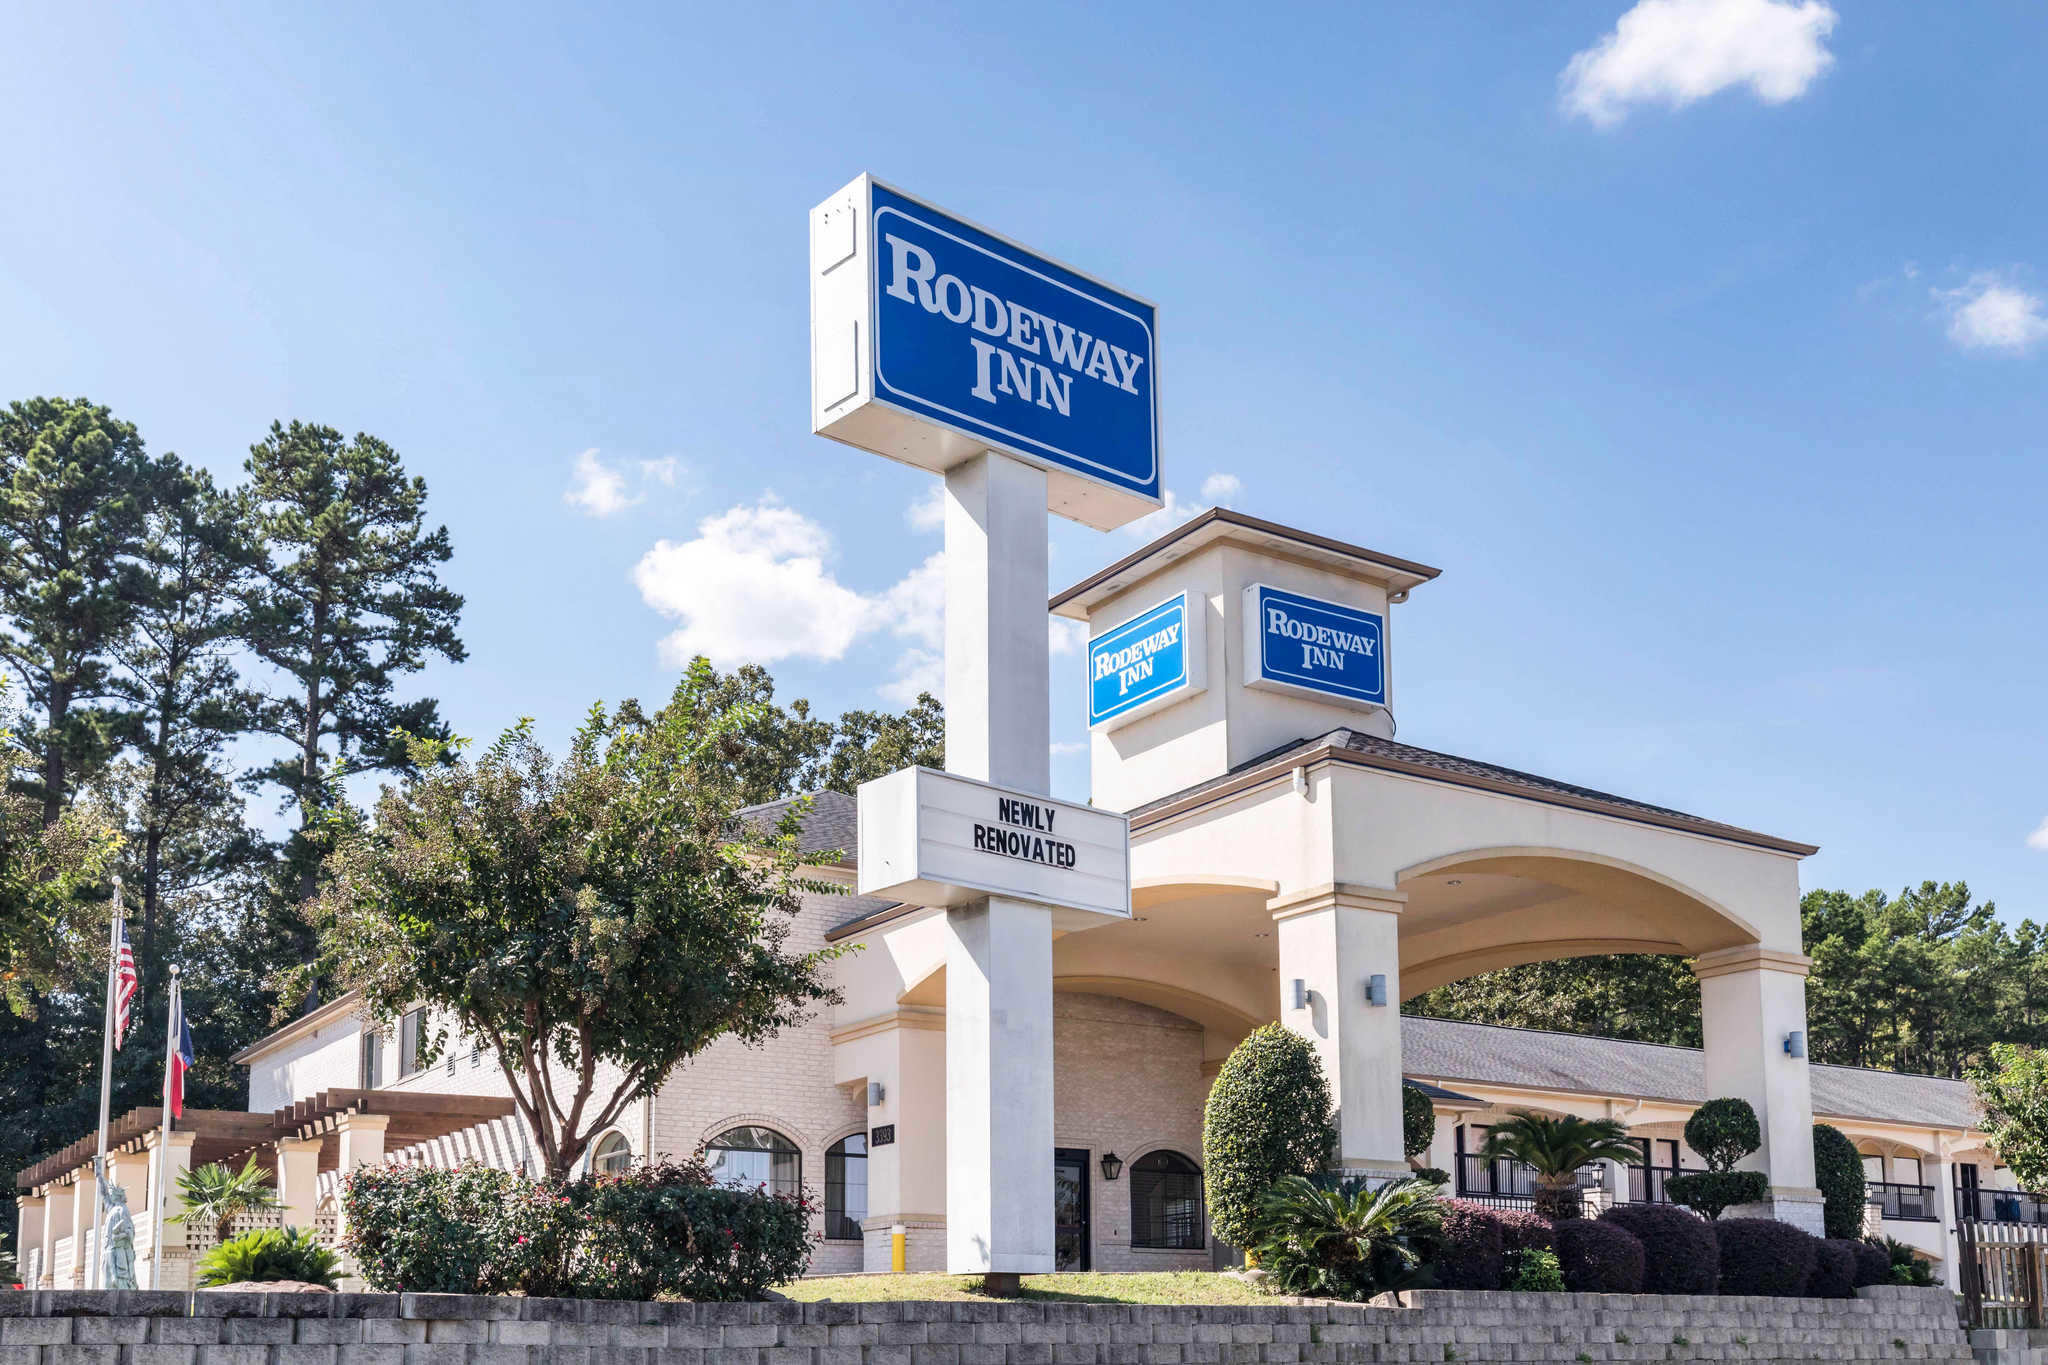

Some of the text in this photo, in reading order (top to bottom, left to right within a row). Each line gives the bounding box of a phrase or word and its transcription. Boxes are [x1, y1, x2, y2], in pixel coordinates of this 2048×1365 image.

[886, 233, 1143, 395] RODEWAY
[971, 338, 1072, 416] INN
[1094, 622, 1180, 680] RODEWAY
[1267, 608, 1375, 656] RODEWAY
[1119, 657, 1154, 696] INN
[1302, 644, 1345, 670] INN
[999, 798, 1055, 832] NEWLY
[974, 824, 1075, 867] RENOVATED
